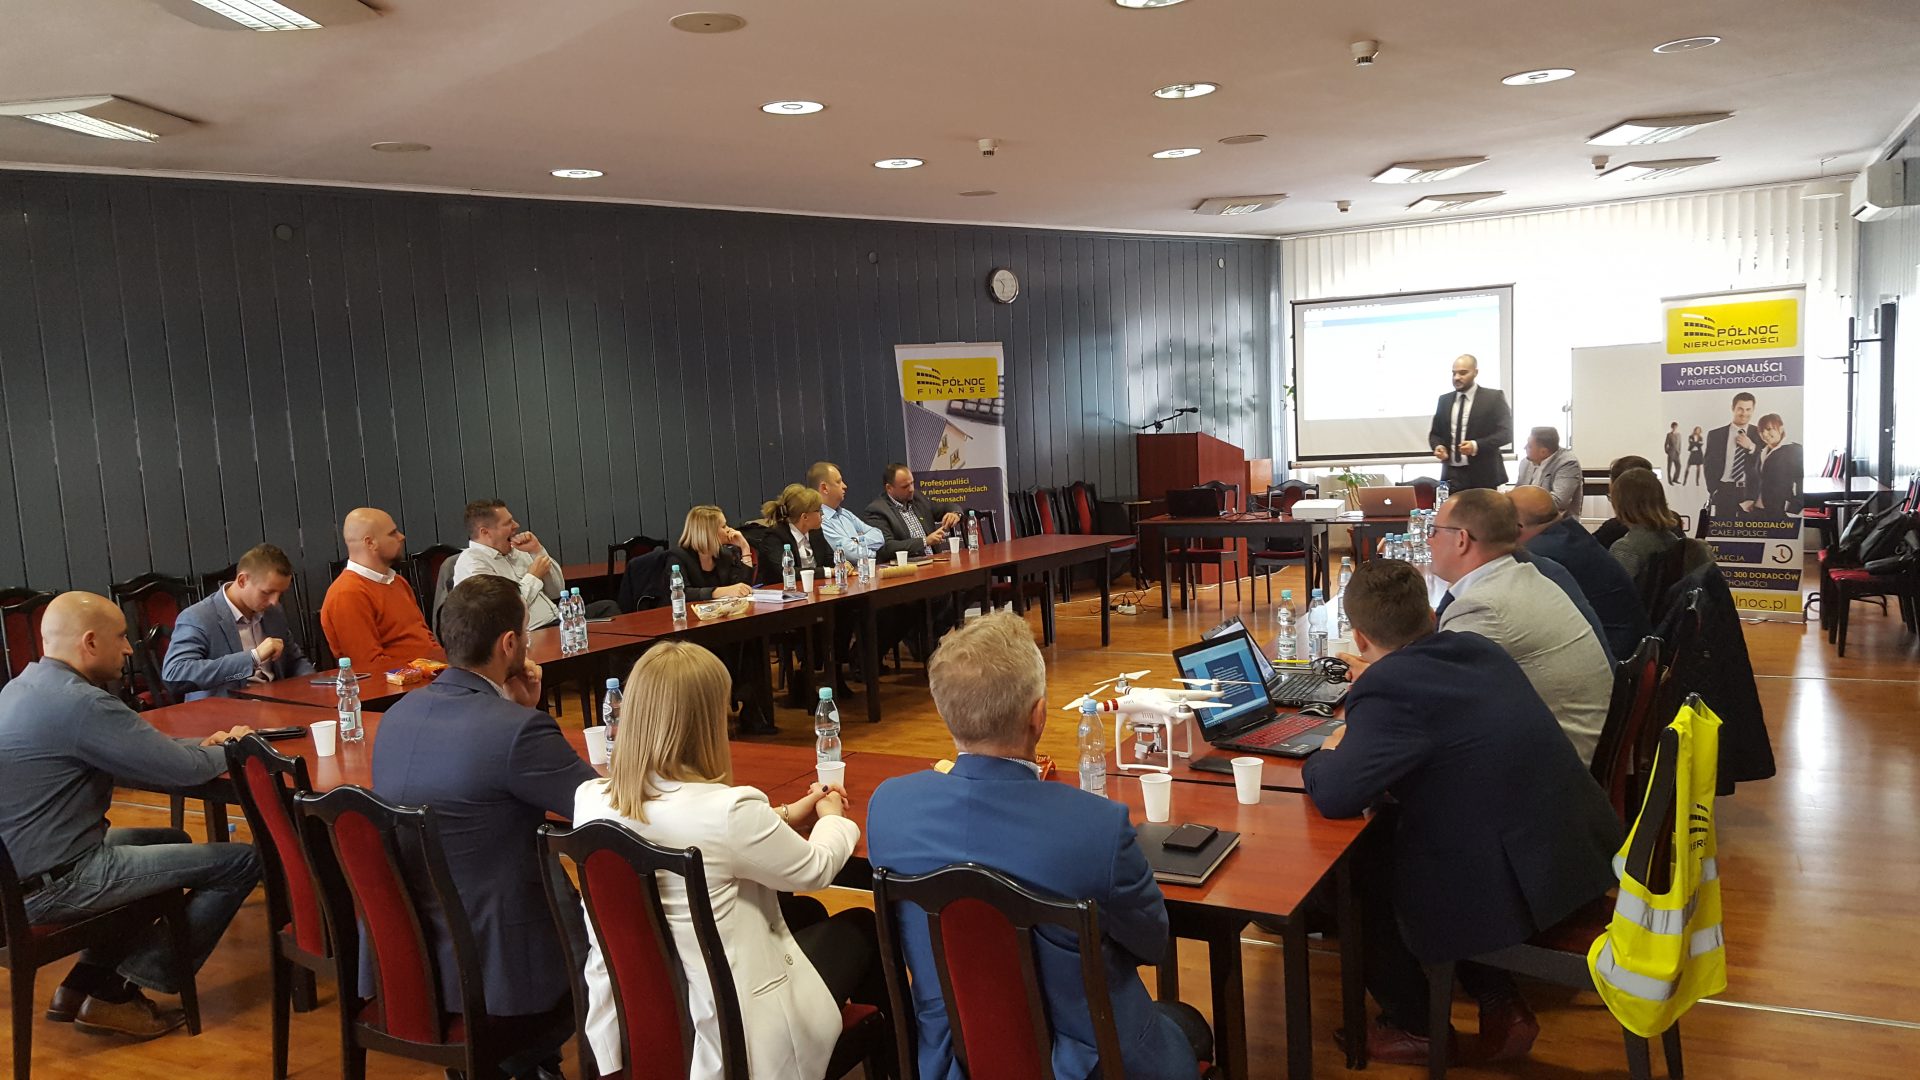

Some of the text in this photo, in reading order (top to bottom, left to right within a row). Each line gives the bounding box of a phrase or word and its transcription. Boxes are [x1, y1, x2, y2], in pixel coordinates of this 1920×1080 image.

[1717, 325, 1779, 338] PÓŁNOC
[1683, 336, 1779, 349] NIERUCHOMOŚCI
[1680, 360, 1783, 377] PROFESJONALIŚCI
[942, 376, 985, 387] PÓŁNOC
[1676, 373, 1787, 386] w nieruchomościach
[917, 386, 986, 395] FINANSE
[920, 477, 970, 488] Profesjonaliści
[928, 485, 988, 496] nieruchomościach
[1745, 519, 1794, 529] ODDZIAŁÓW
[1737, 529, 1768, 537] POLSCE
[1749, 571, 1799, 580] DORADCÓW
[1728, 579, 1768, 588] HOMOŚCI
[1736, 595, 1787, 611] lnoc.pl
